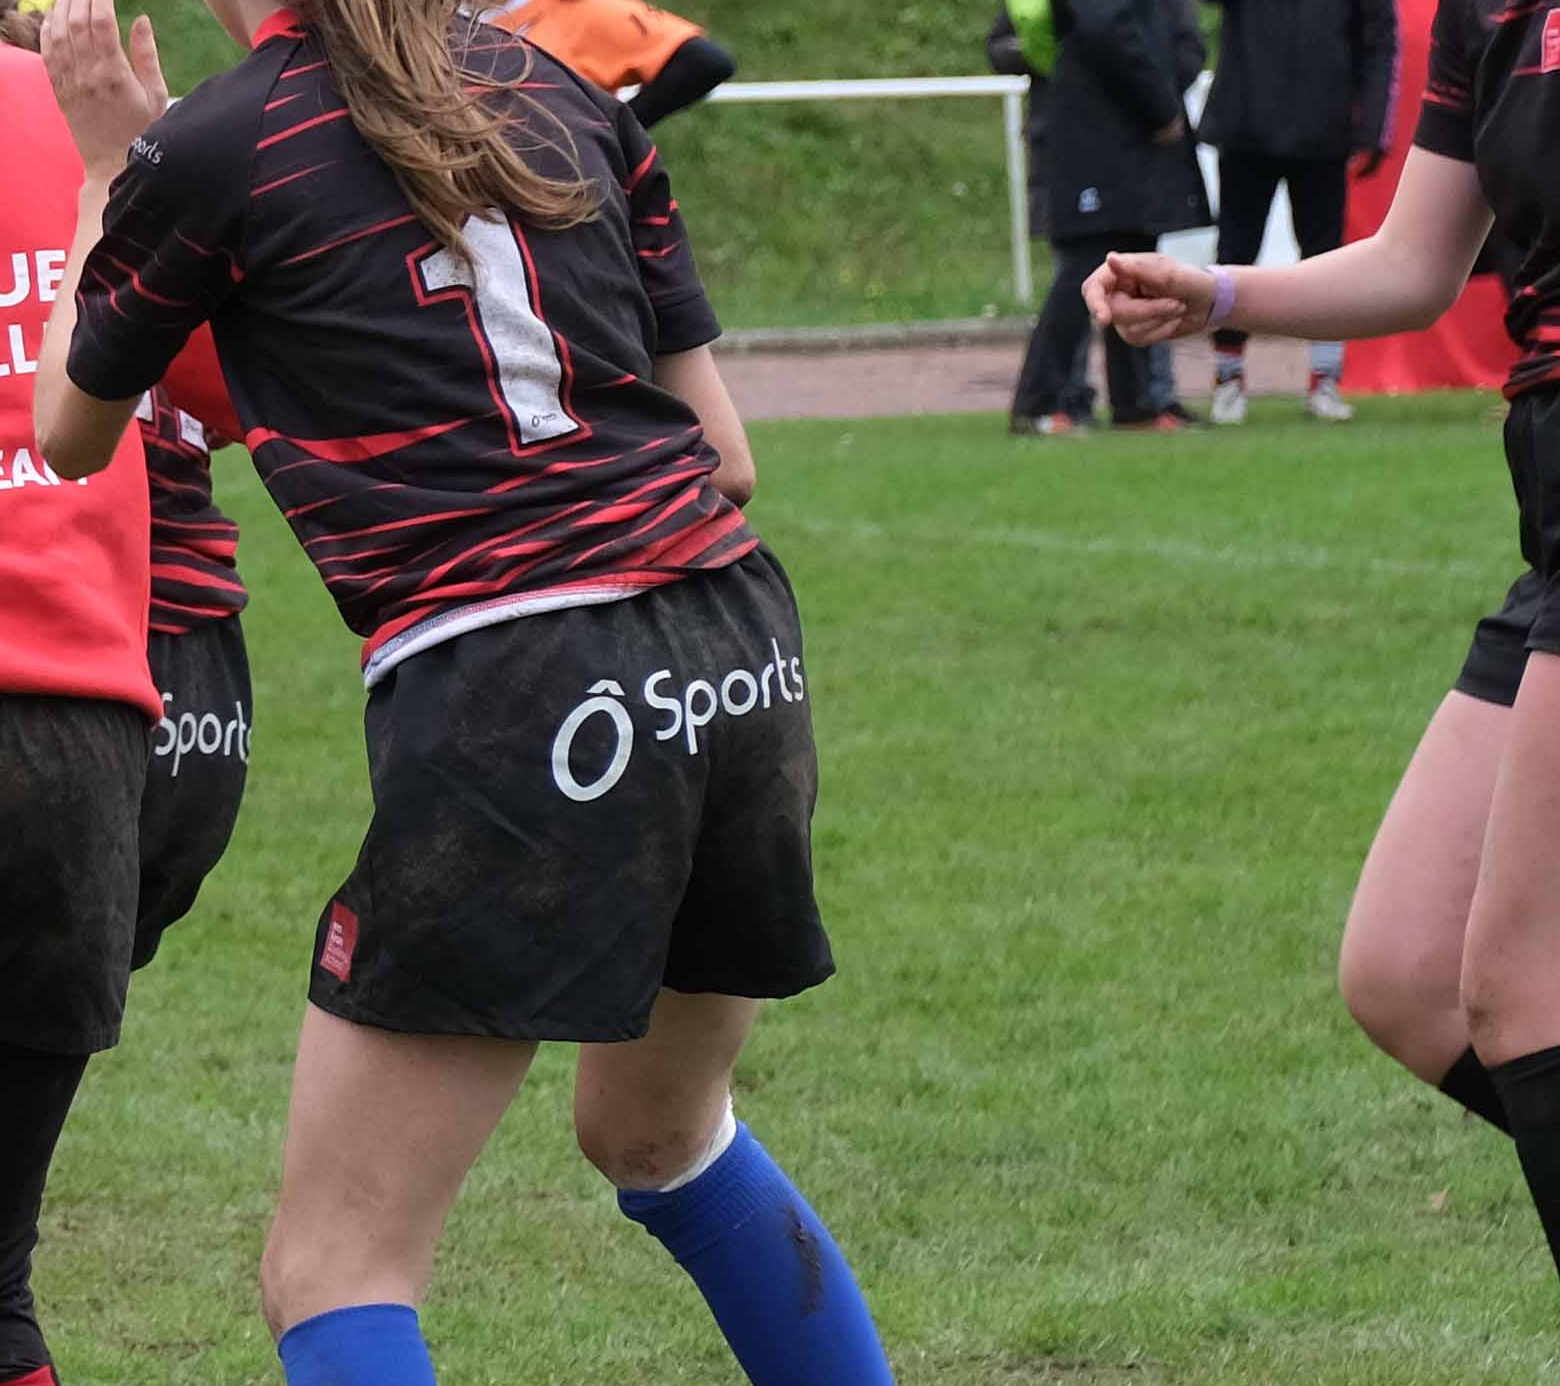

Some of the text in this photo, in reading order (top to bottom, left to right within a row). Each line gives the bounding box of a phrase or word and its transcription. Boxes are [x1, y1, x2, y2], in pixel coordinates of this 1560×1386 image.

[410, 208, 590, 453] 1
[153, 691, 252, 778] Sport
[549, 636, 807, 803] Ô Sports
